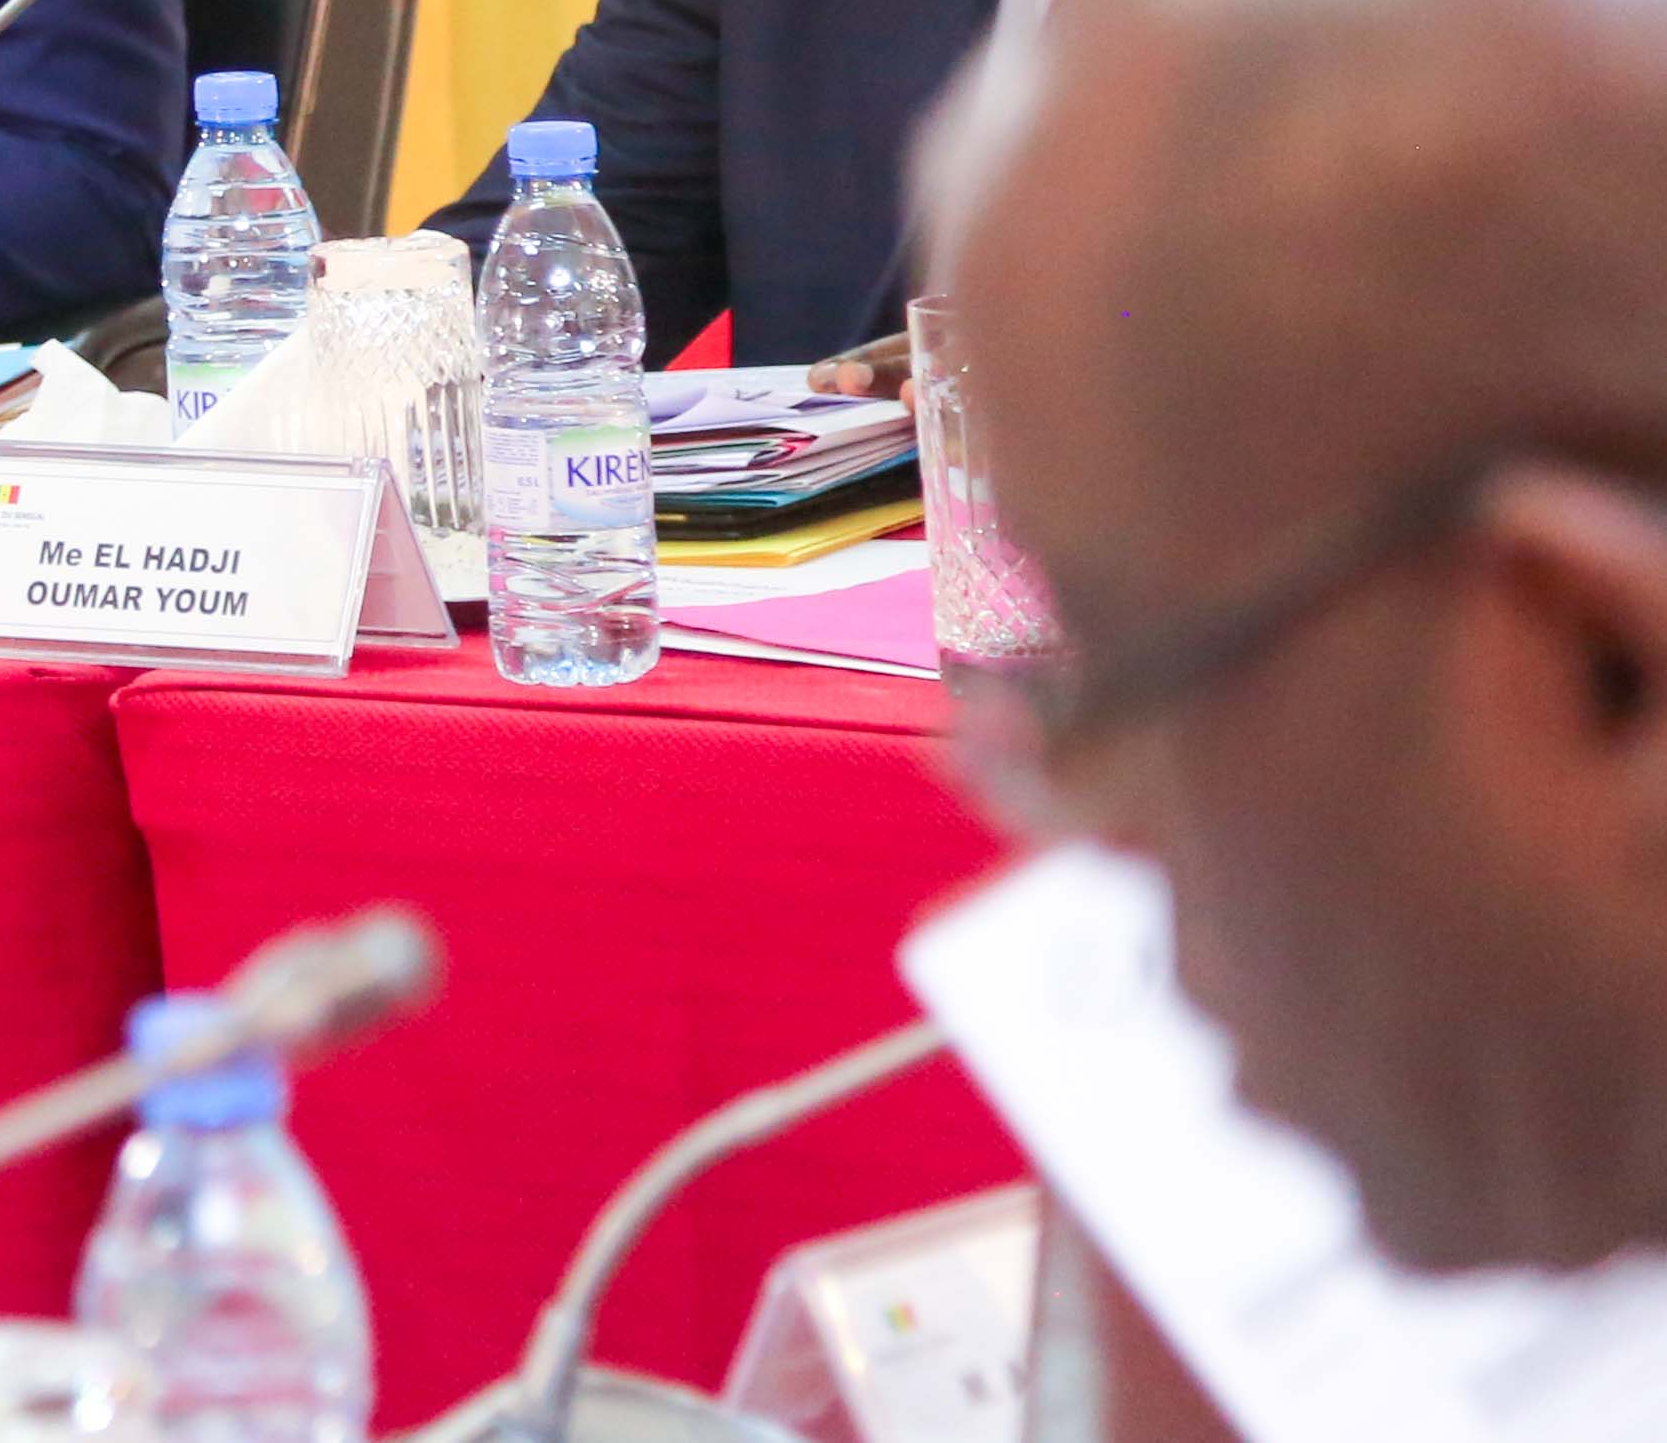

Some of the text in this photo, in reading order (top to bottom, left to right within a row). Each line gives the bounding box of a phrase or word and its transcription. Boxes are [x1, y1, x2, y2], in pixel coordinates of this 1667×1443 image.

[39, 541, 241, 575] Me EL HADJI
[27, 580, 249, 617] OUMAR YOUM
